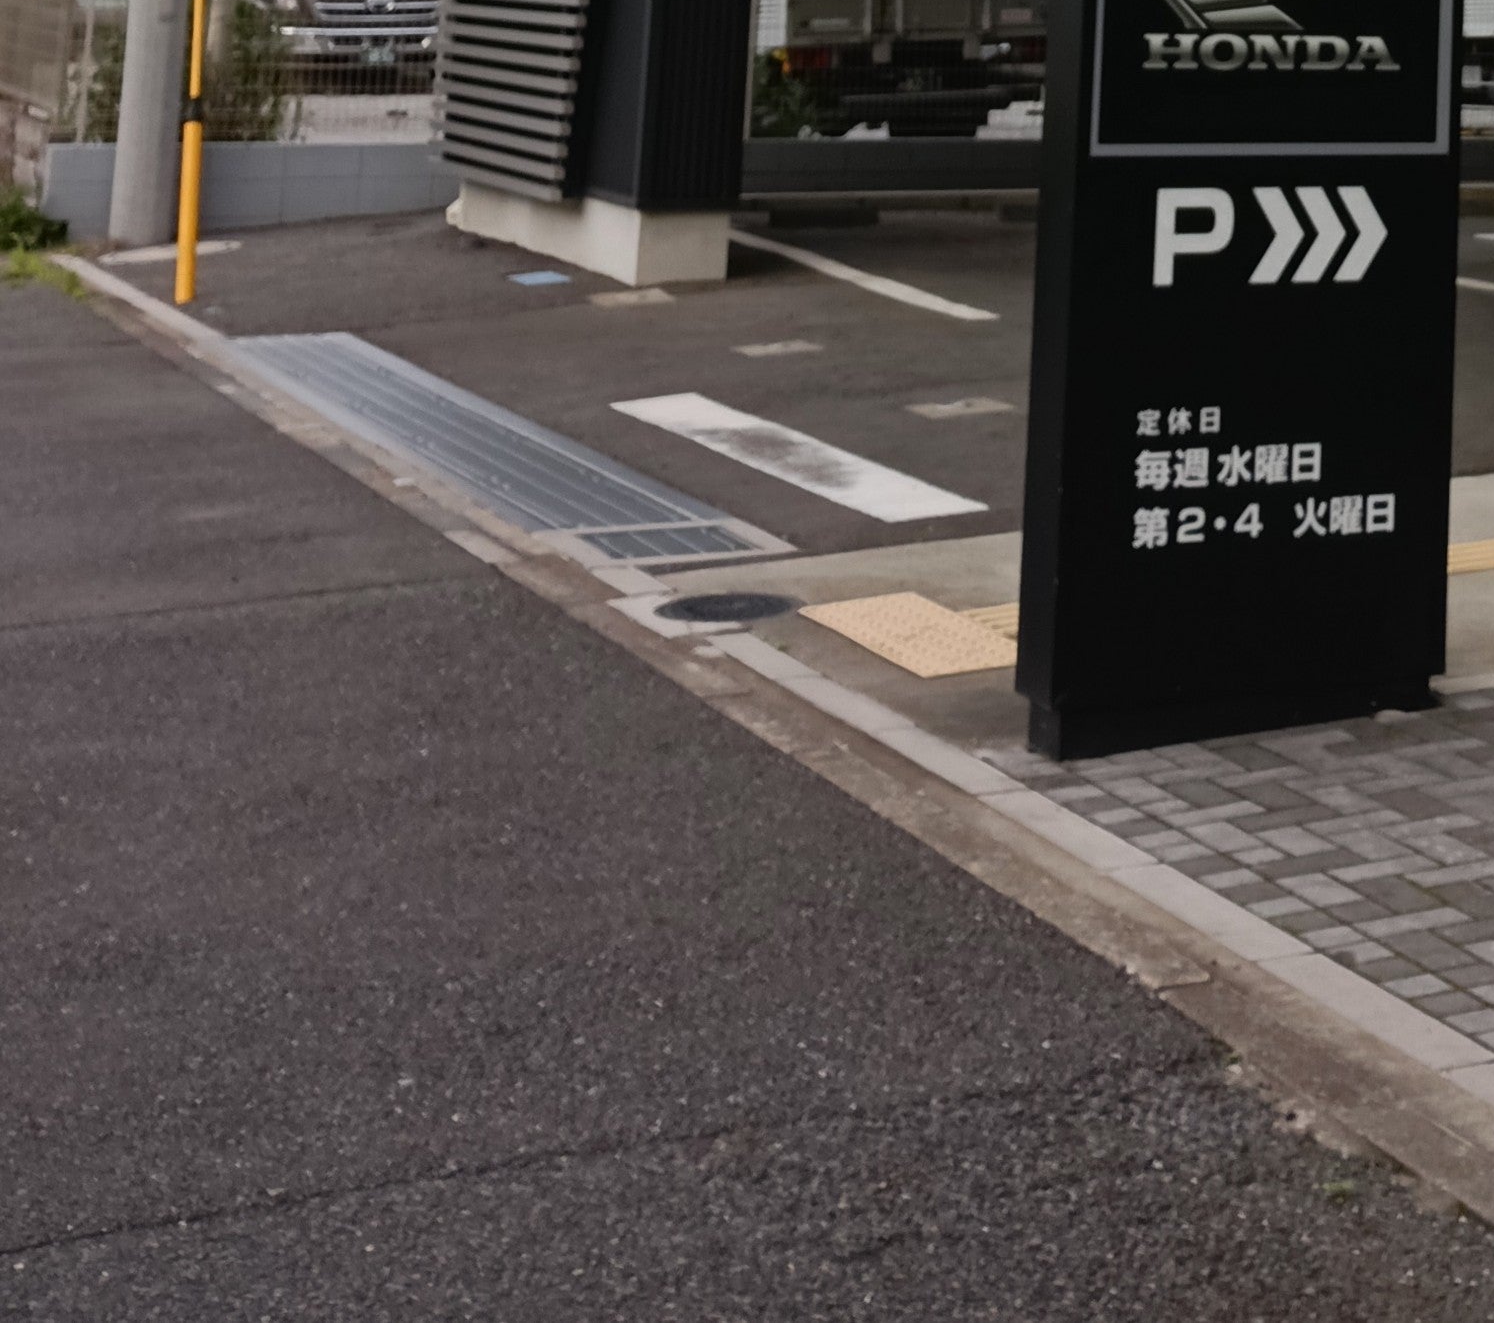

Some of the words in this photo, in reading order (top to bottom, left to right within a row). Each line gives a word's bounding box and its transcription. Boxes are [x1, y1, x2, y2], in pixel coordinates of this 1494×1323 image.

[1143, 33, 1401, 71] HONDA
[1152, 187, 1235, 287] P
[1136, 406, 1221, 436] 定休日
[1293, 493, 1396, 538] 火曜日
